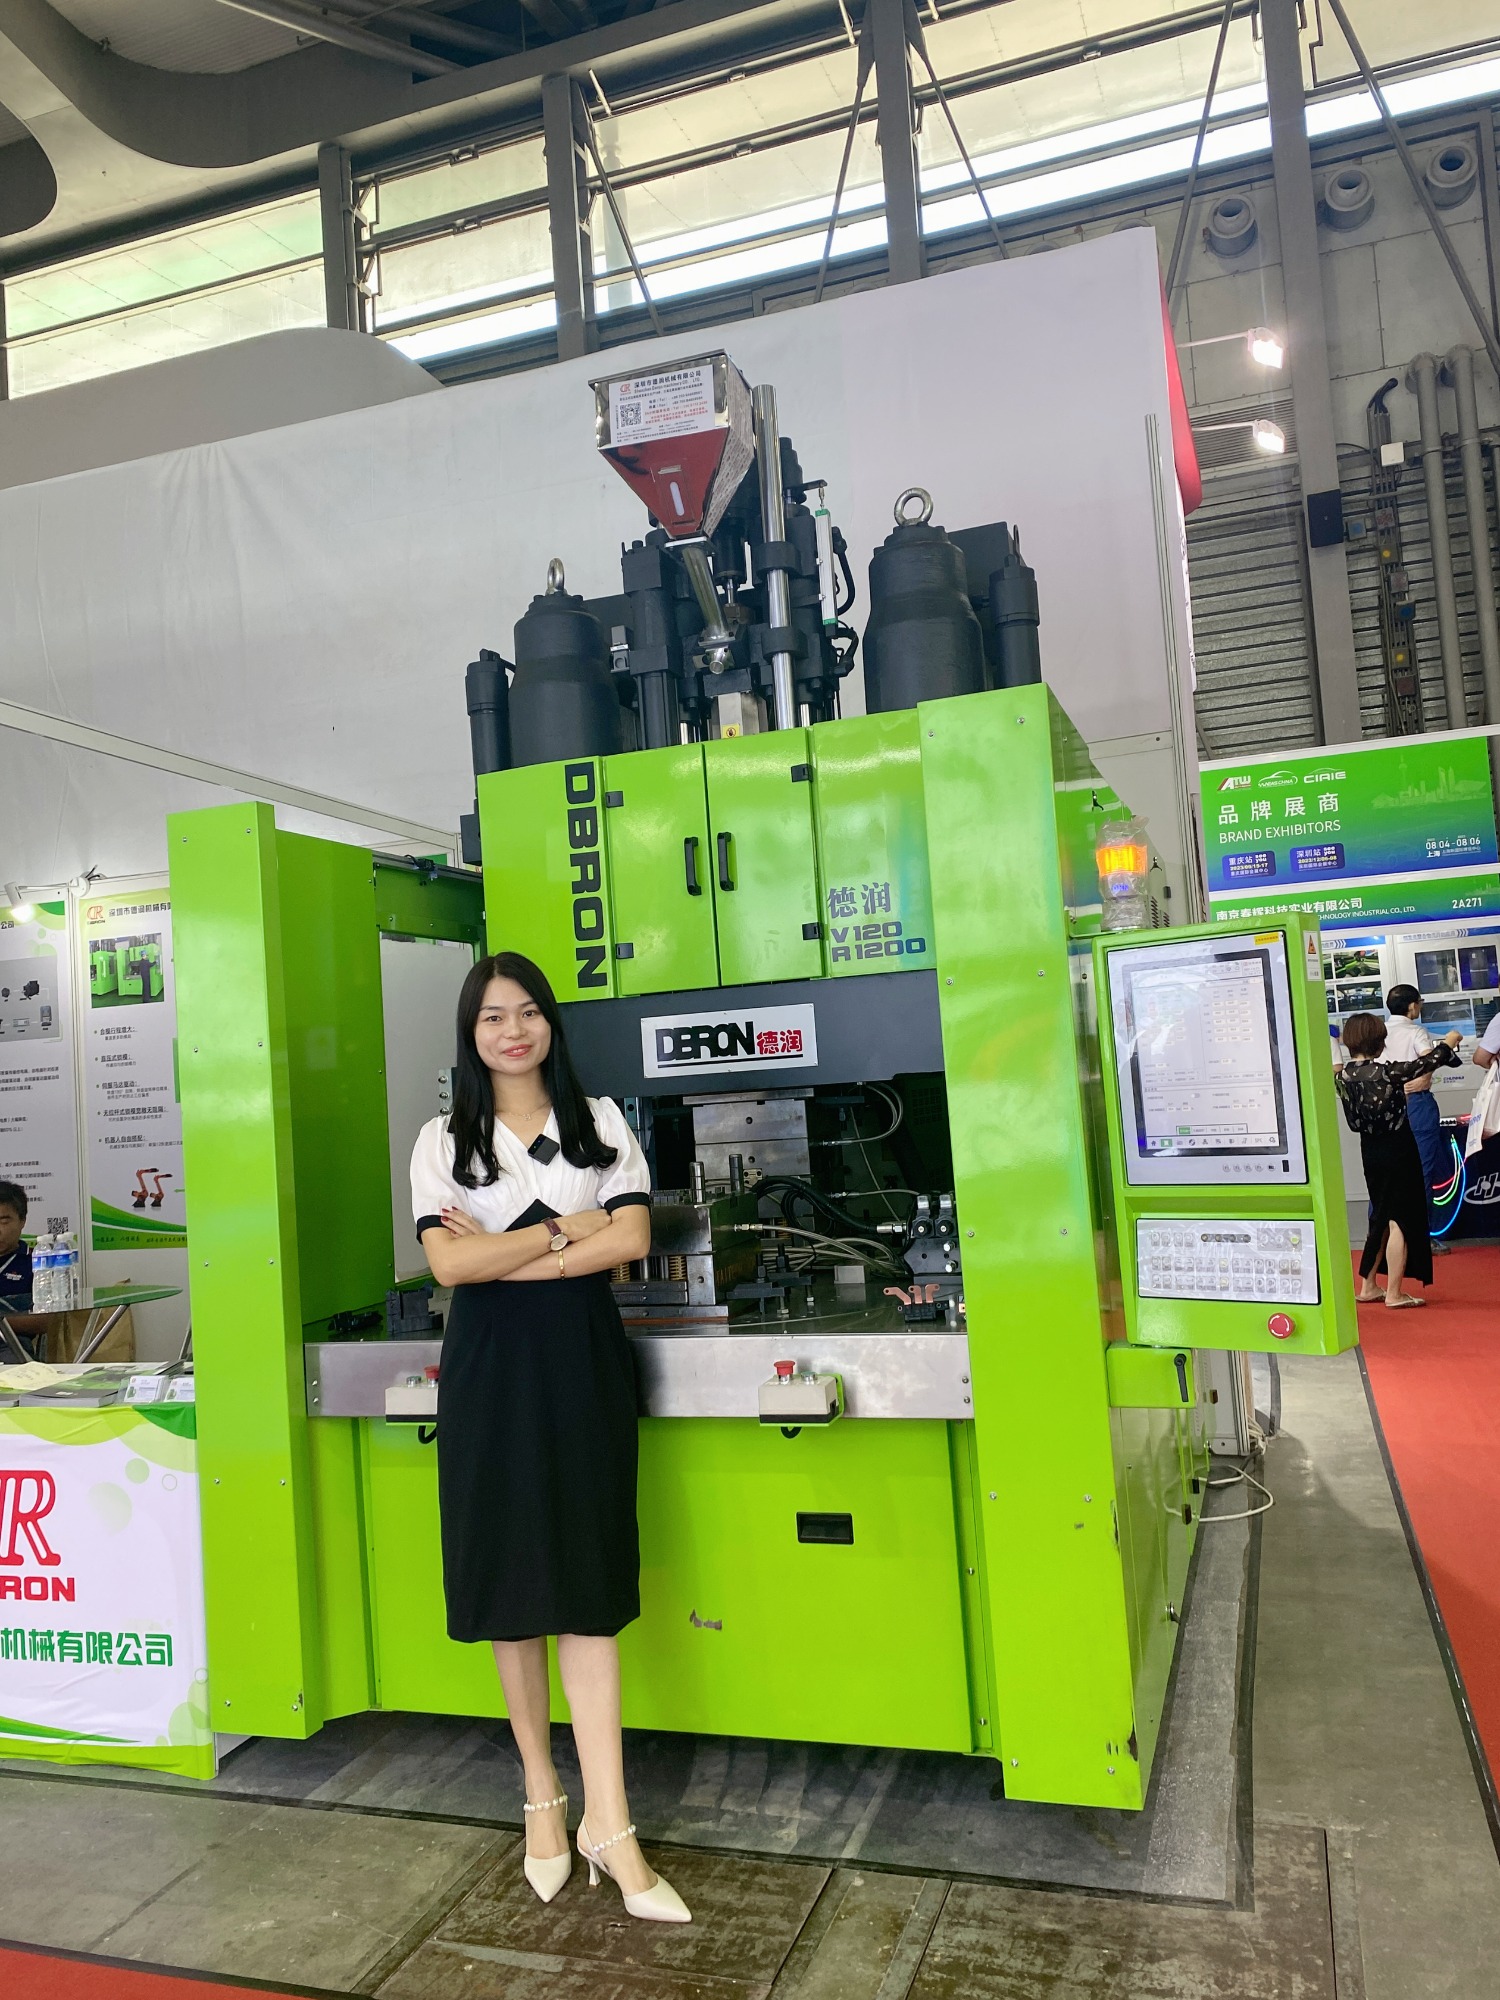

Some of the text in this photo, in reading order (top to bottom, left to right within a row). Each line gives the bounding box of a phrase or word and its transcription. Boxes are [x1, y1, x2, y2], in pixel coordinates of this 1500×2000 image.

[1218, 792, 1339, 825] 品牌展商
[1220, 820, 1341, 844] BRAND EXHIBITORS
[1426, 842, 1436, 850] 08
[1439, 840, 1450, 848] 04
[1457, 838, 1467, 847] 08
[1470, 837, 1480, 845] 06
[1228, 855, 1253, 865] 重庆站
[1296, 848, 1321, 858] 深圳站
[828, 882, 892, 919] 德润
[1452, 897, 1482, 909] 2A271
[1353, 909, 1389, 917] INDUSTRIAL
[757, 1030, 803, 1055] 德润
[0, 1628, 173, 1667] 机械有限公司
